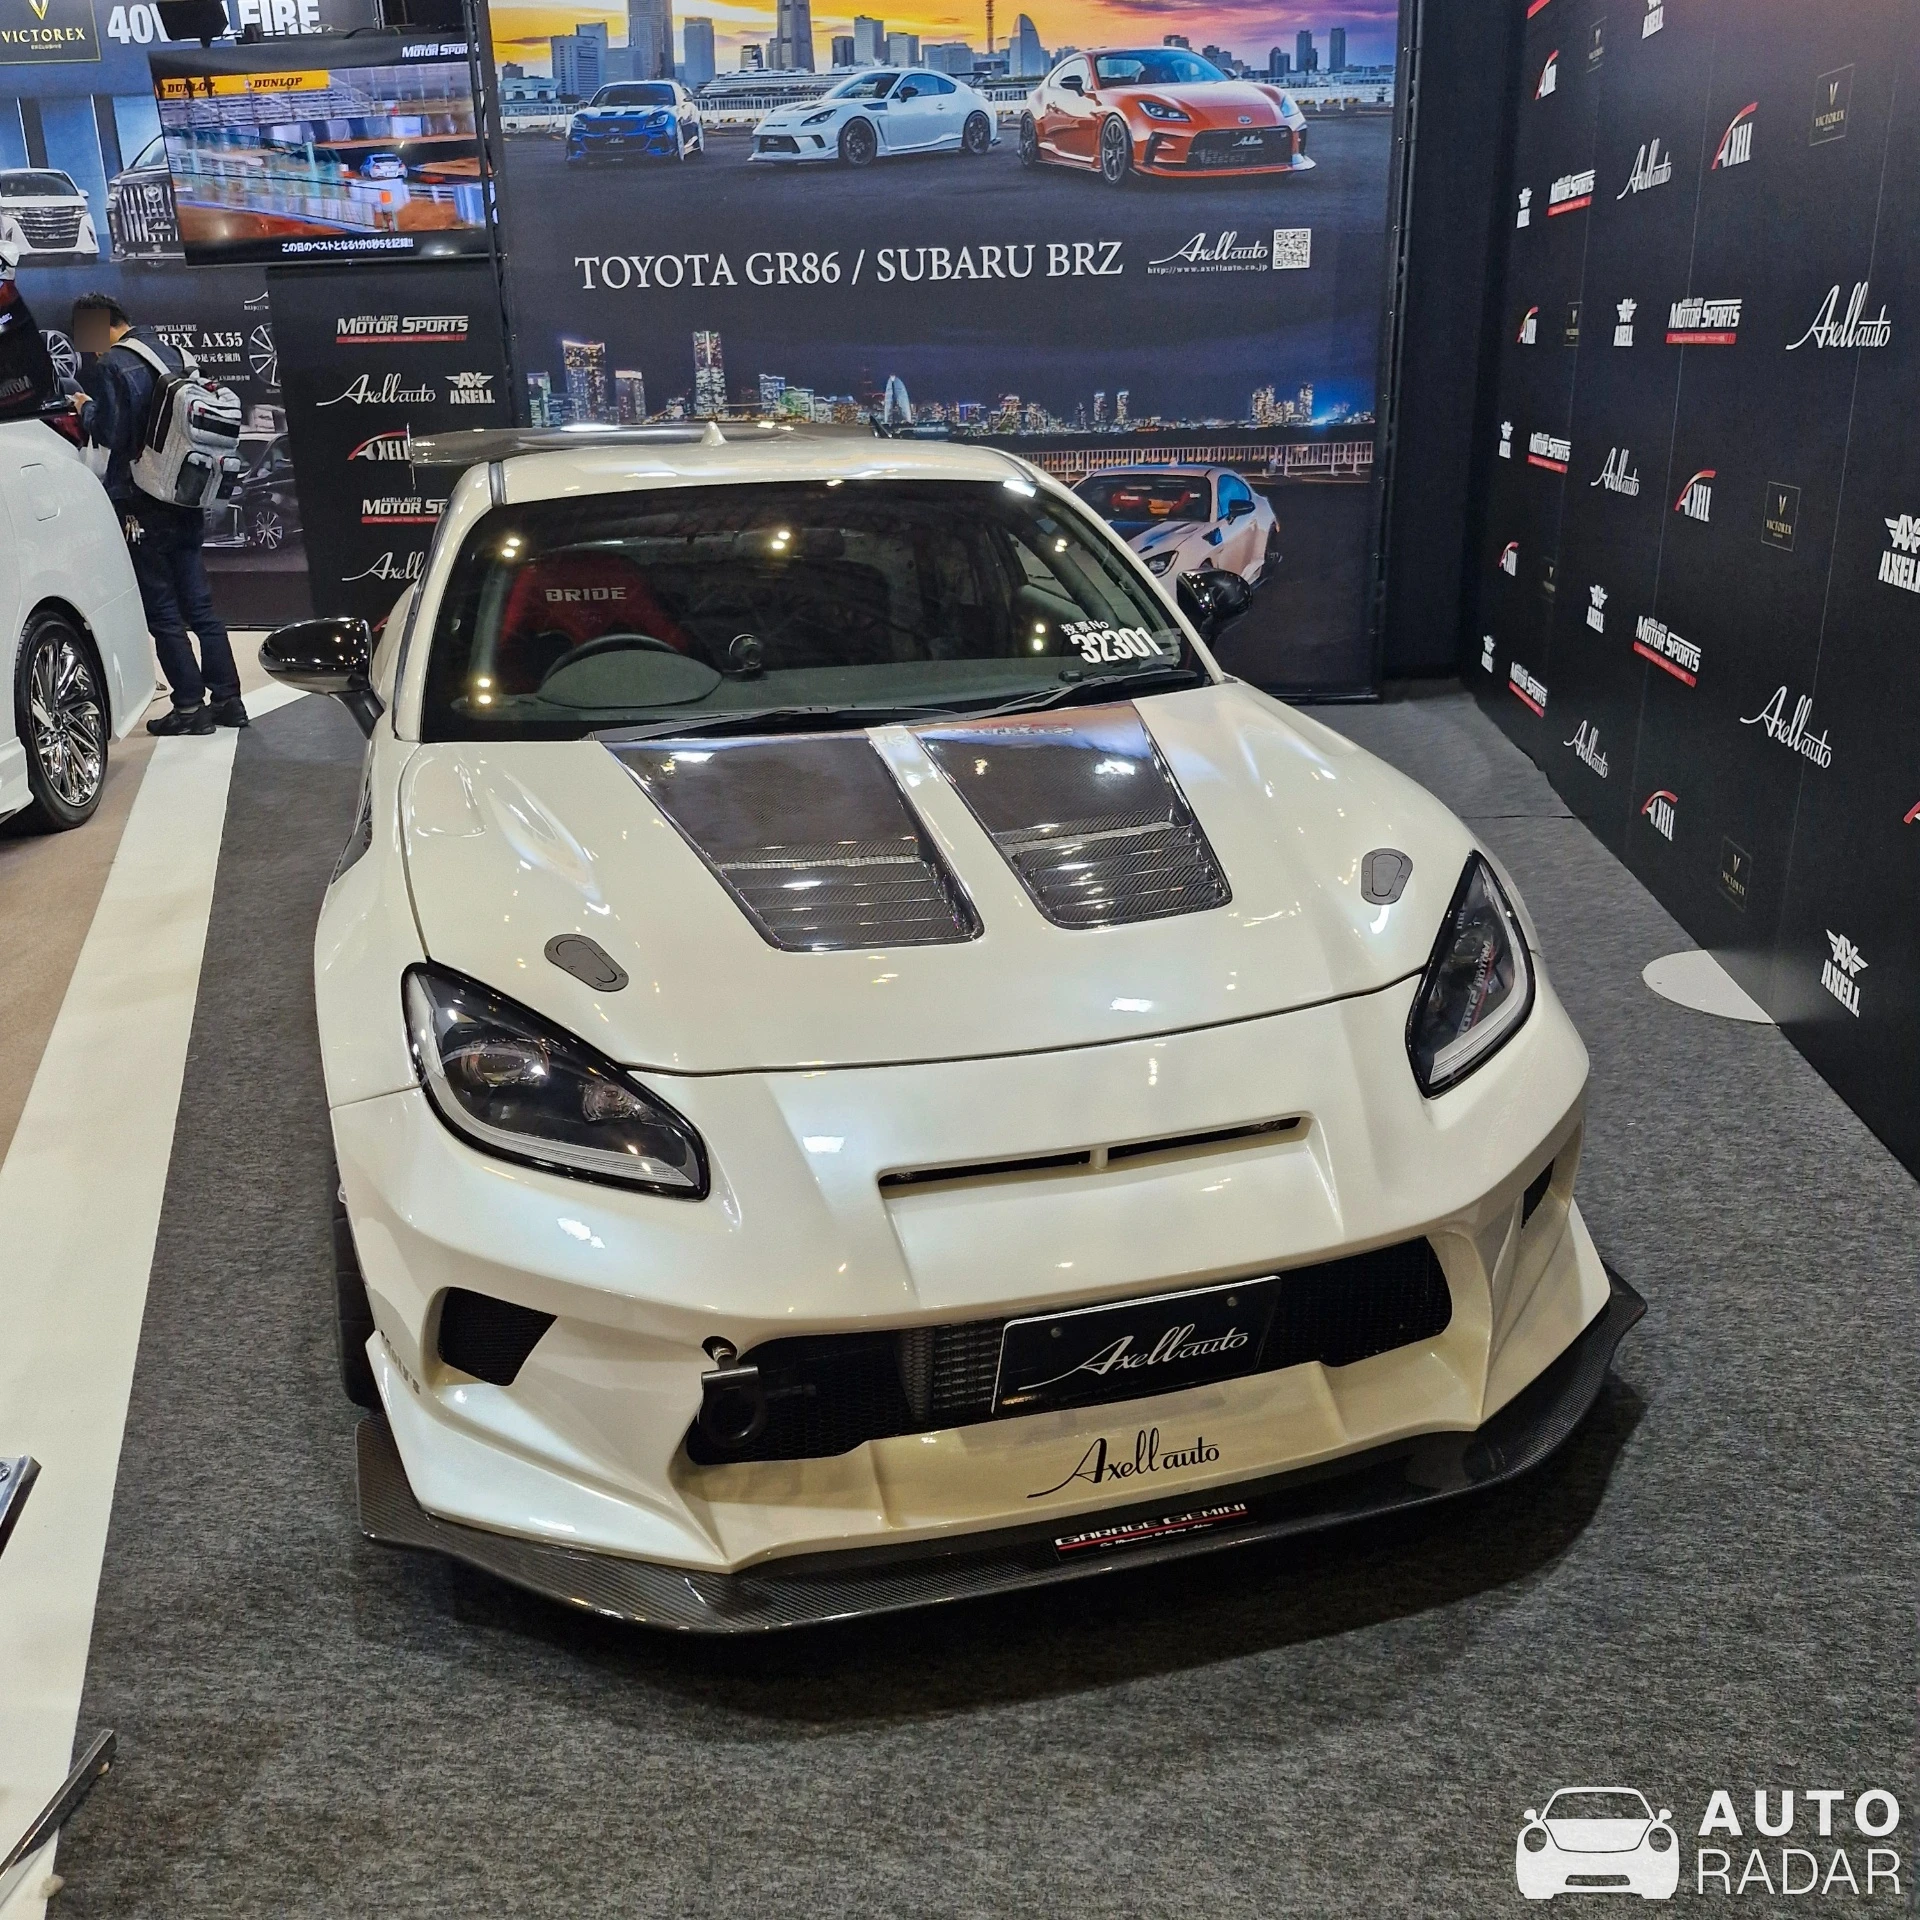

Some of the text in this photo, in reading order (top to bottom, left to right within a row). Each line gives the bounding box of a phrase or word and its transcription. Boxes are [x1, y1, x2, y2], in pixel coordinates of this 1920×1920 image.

[2, 27, 86, 43] VICTOREX
[254, 77, 302, 88] DUNLOP
[574, 241, 1123, 289] TOYOTA GR86 / SUBARU BRZ
[1147, 263, 1268, 274] http://www.axellauto.co.jp
[1668, 299, 1742, 328] MOTOR SPORTS
[337, 315, 469, 334] MOTOR SPORTS
[201, 332, 244, 347] AX55
[450, 389, 495, 404] AXELL
[362, 499, 421, 515] MOTOR
[545, 587, 627, 602] BRIDE
[1070, 627, 1164, 664] 32301
[1635, 615, 1667, 652] MOTOR
[1665, 631, 1701, 673] SPORTS
[1820, 959, 1860, 1018] AXELL
[1054, 1503, 1247, 1546] GARAGE GEMINI
